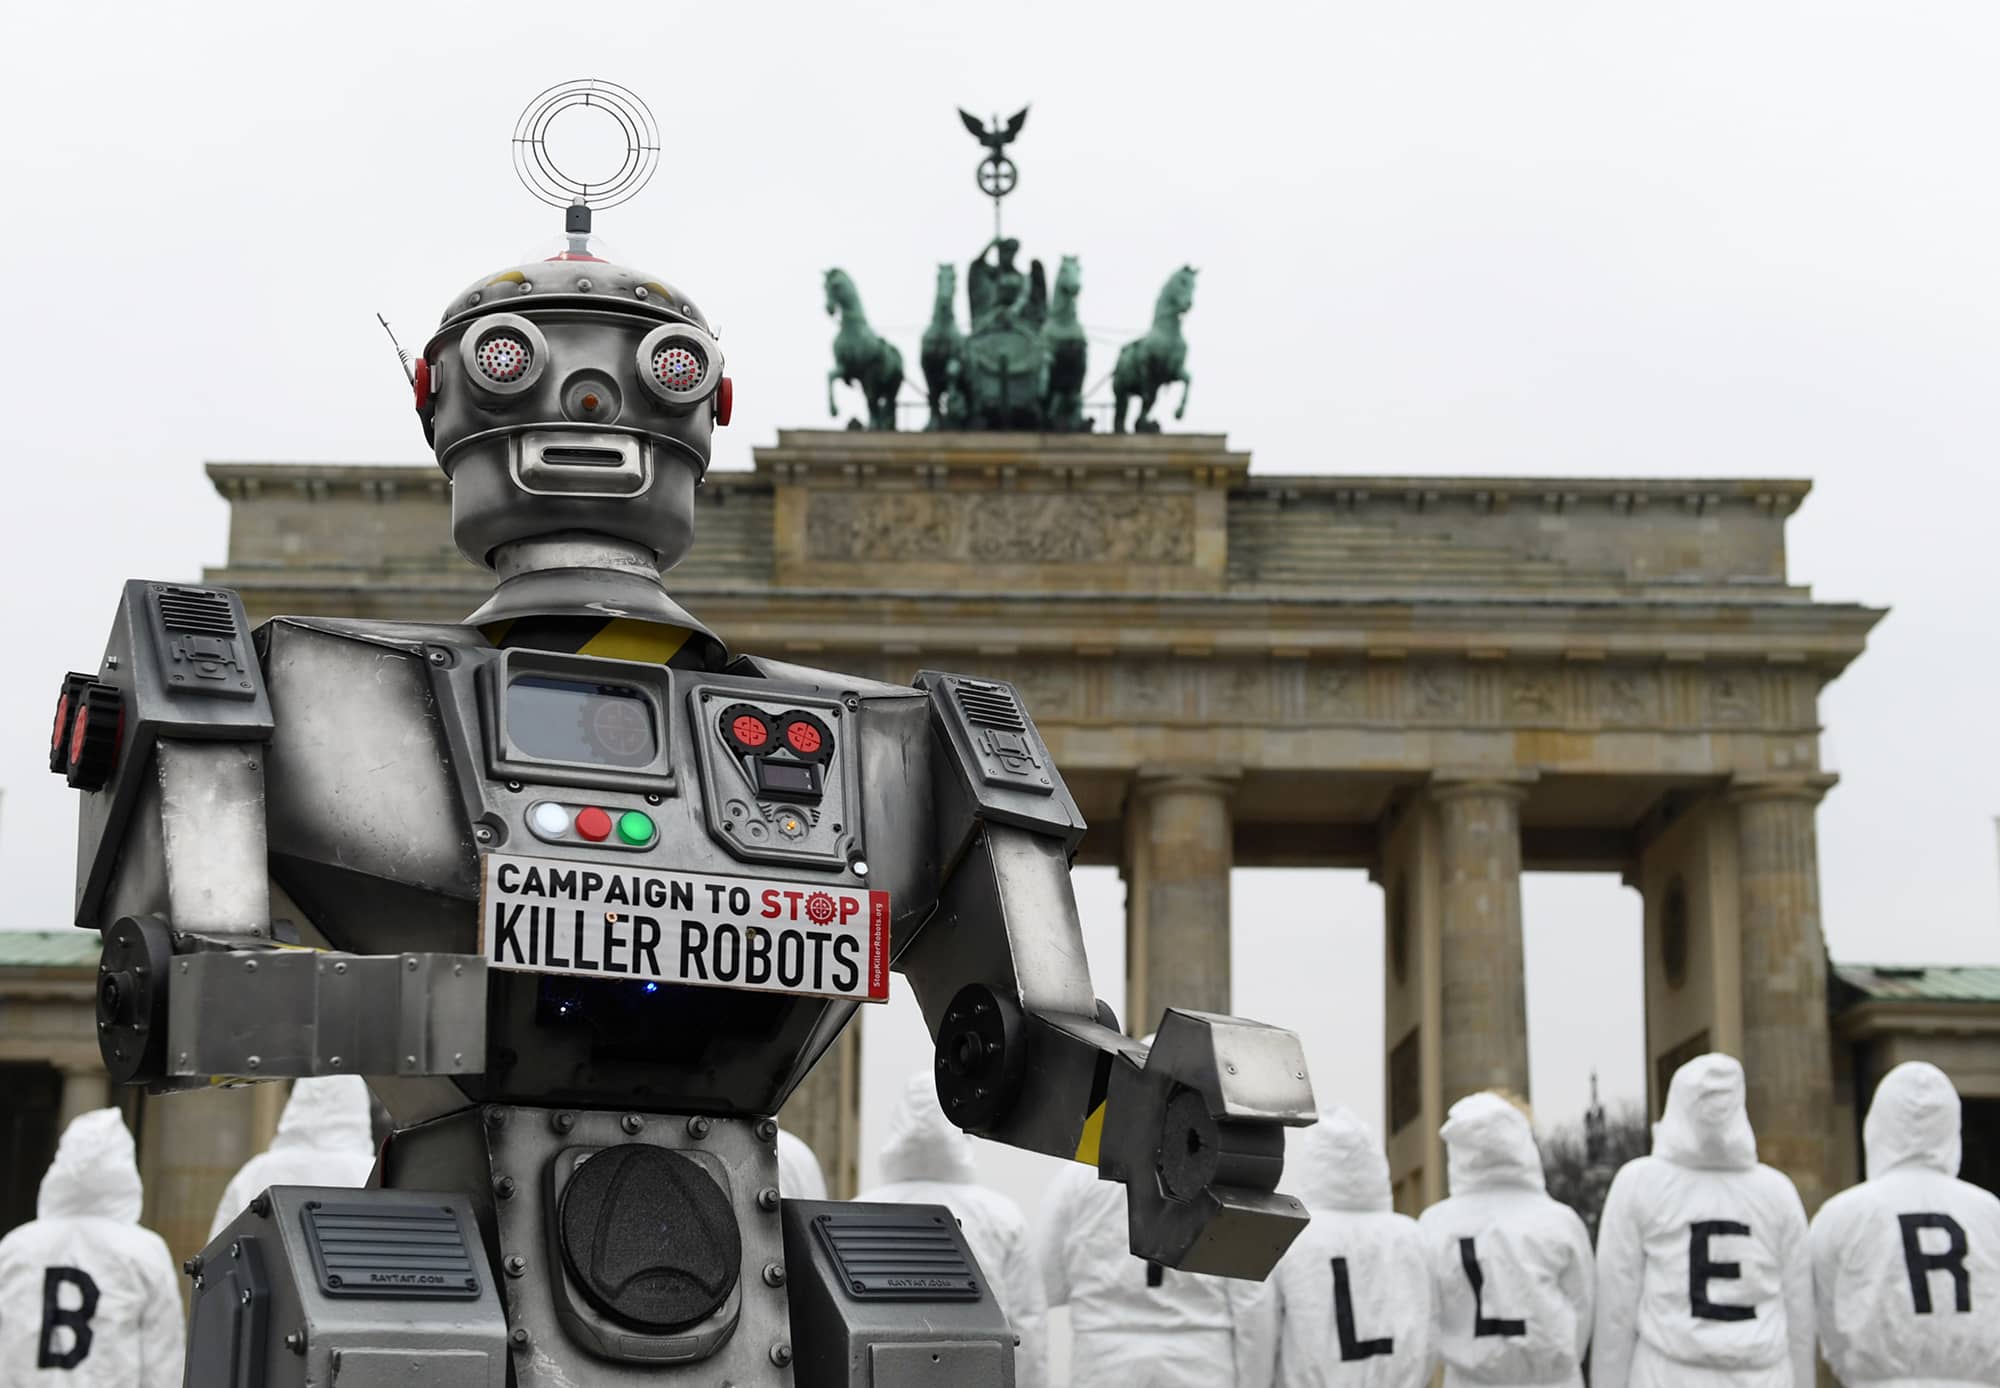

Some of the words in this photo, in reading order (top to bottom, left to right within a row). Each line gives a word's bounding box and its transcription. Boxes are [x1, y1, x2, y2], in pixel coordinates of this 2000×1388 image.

[497, 863, 694, 912] CAMPAIGN
[704, 884, 751, 917] TO
[761, 890, 860, 926] STOP
[872, 902, 884, 988] StopKillerRobots.org
[494, 901, 662, 977] KILLER
[679, 919, 860, 993] ROBOTS
[370, 1273, 445, 1284] RAYTAIT.COM
[1330, 1257, 1394, 1363] L
[1459, 1237, 1527, 1338] L
[1688, 1219, 1757, 1323] E
[1898, 1212, 1972, 1315] R
[37, 1266, 101, 1371] B
